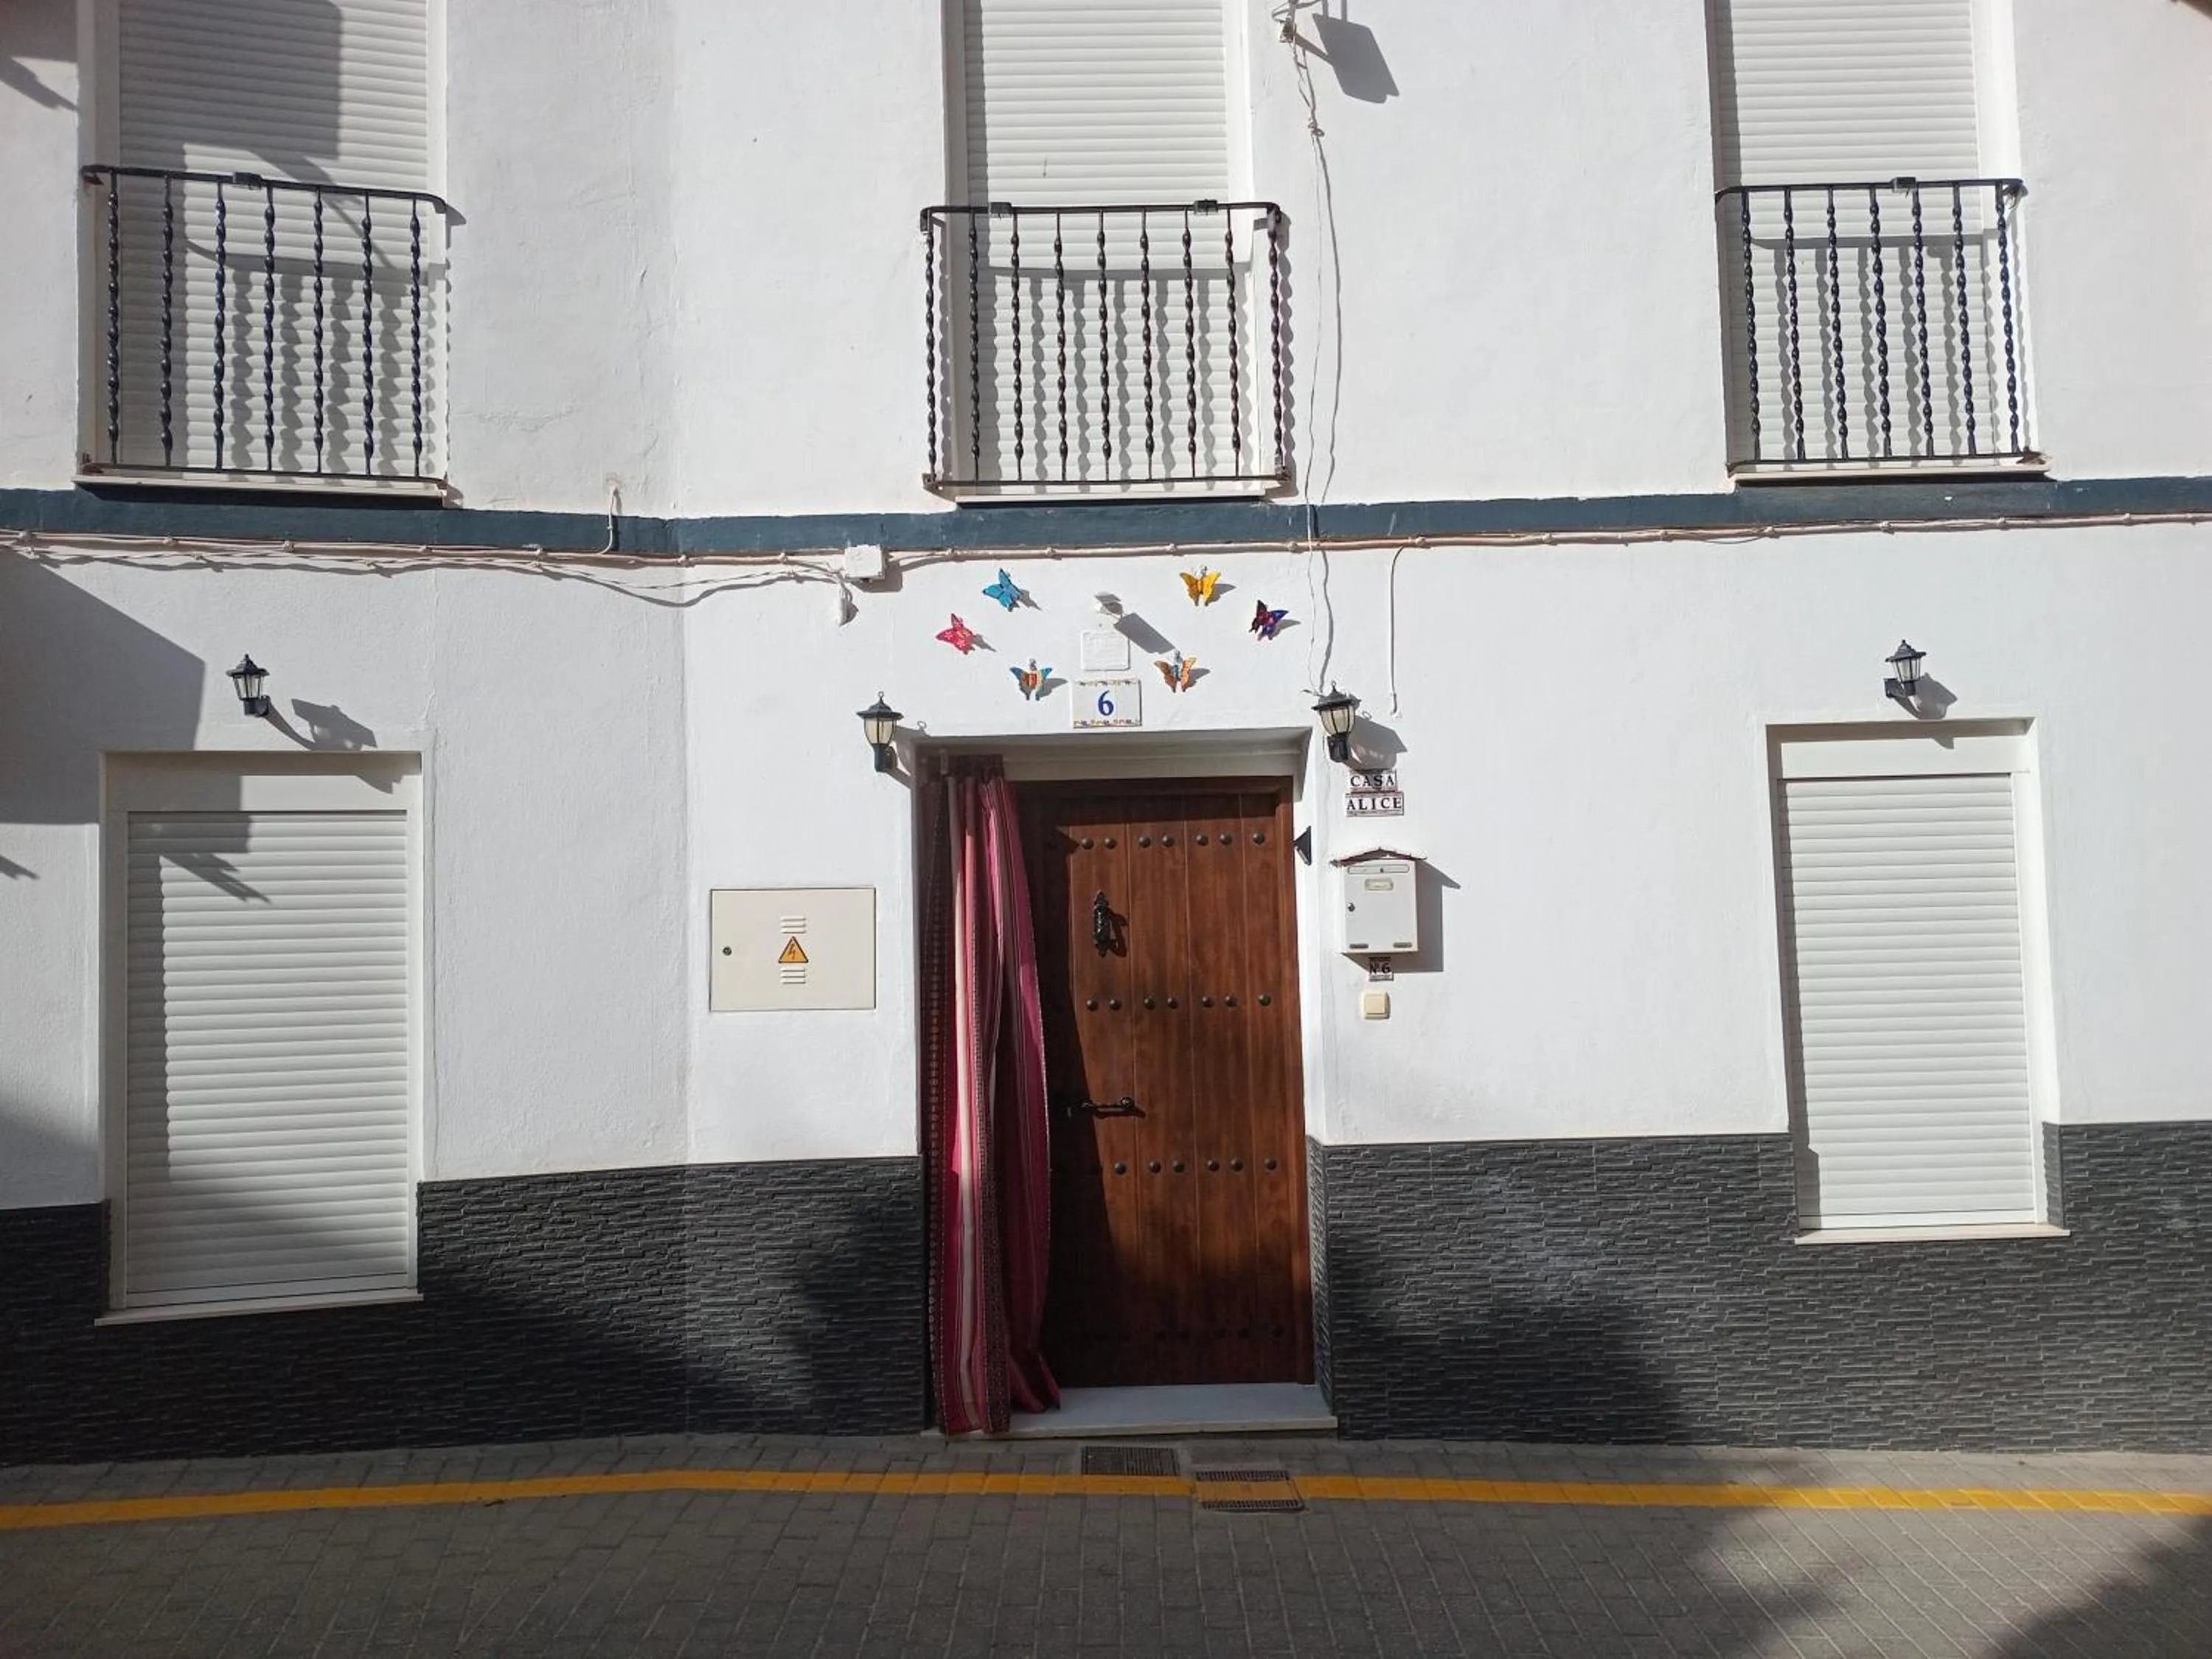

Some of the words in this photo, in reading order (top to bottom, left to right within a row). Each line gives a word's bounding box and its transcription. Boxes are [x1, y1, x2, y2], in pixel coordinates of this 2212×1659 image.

[1098, 690, 1114, 716] 6
[1350, 775, 1394, 787] CASA
[1347, 797, 1402, 810] ALICE
